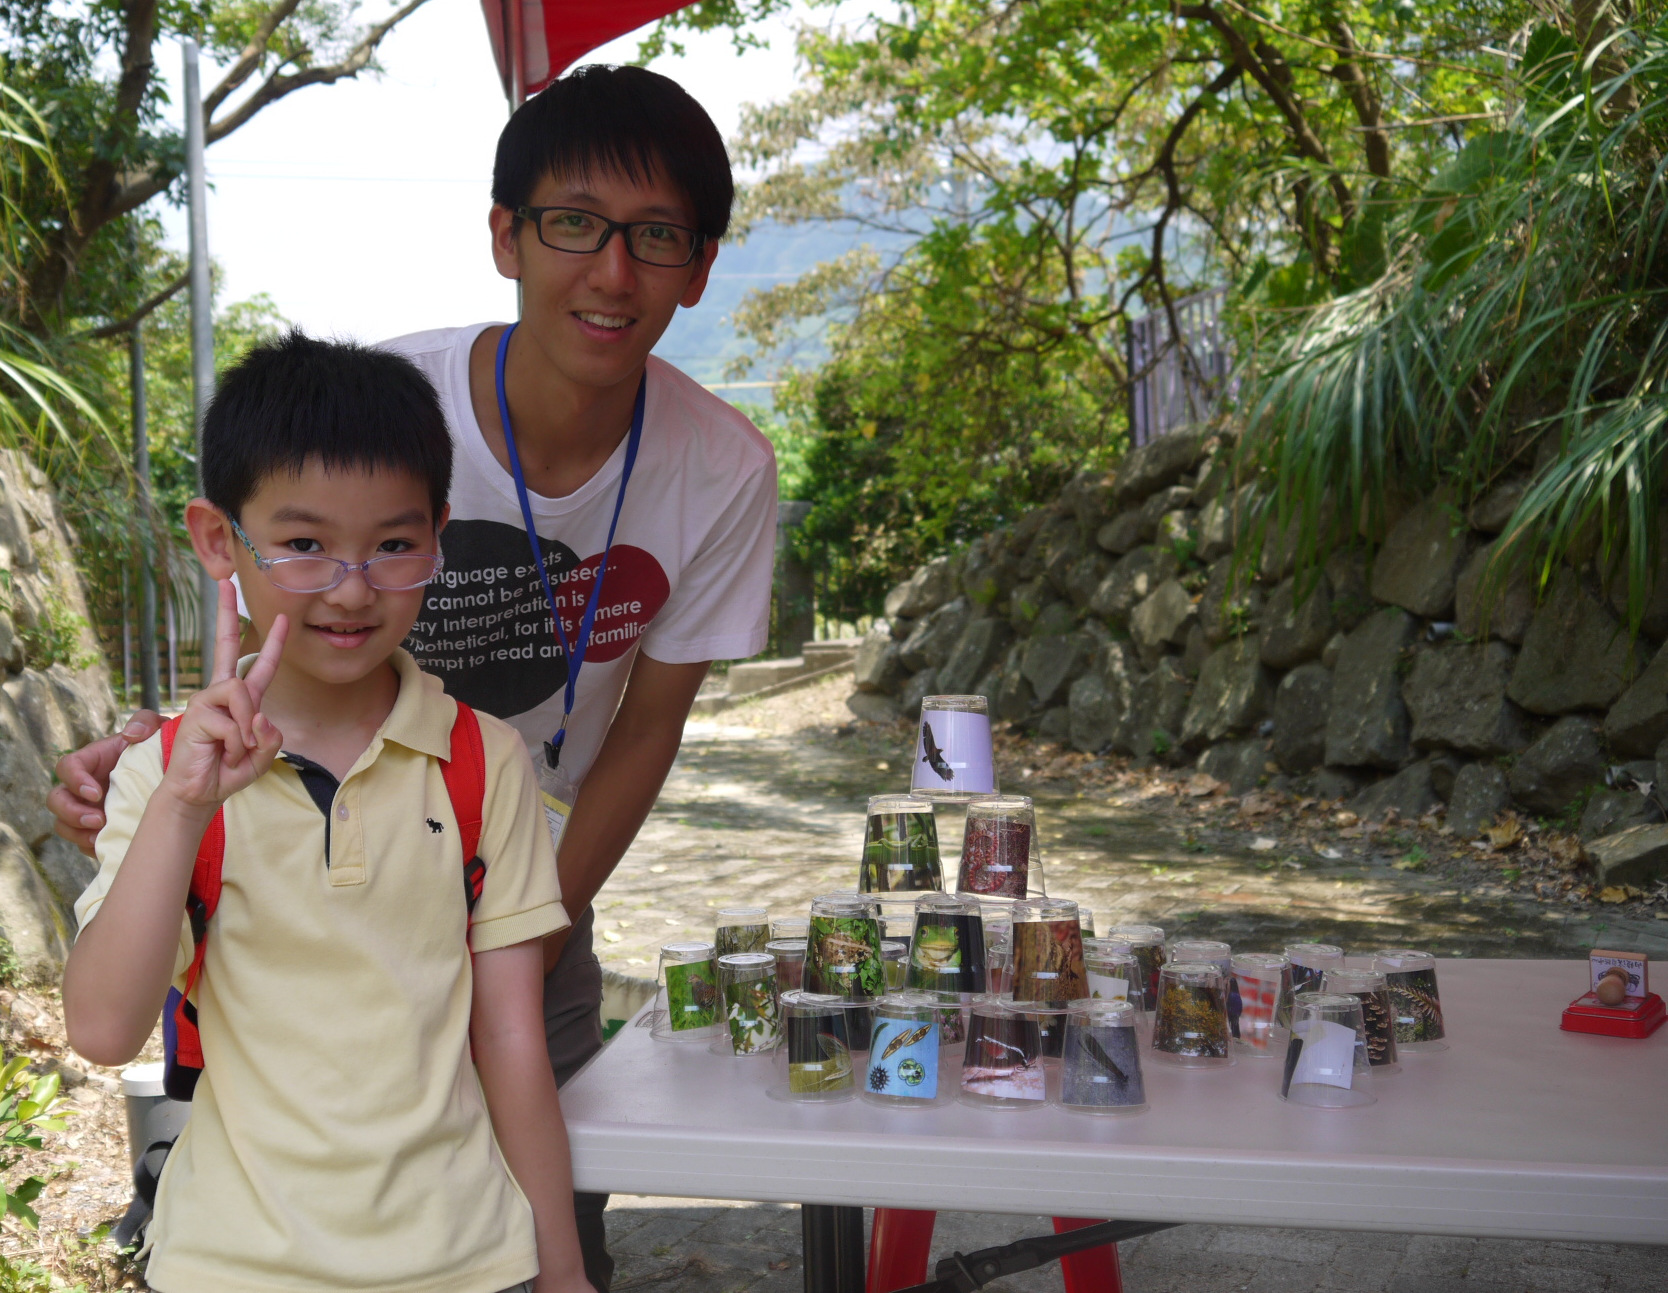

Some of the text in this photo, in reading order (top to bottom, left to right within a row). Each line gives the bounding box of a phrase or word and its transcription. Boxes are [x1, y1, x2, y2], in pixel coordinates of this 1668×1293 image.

[429, 551, 562, 588] nguage exsts
[427, 589, 494, 610] cannot
[501, 587, 523, 602] be
[444, 595, 566, 632] Interpretation
[572, 591, 585, 607] is
[515, 622, 539, 636] for
[545, 617, 555, 633] it
[560, 617, 573, 632] is
[595, 601, 641, 621] mere
[469, 655, 485, 668] to
[490, 643, 533, 661] read
[540, 645, 563, 657] an
